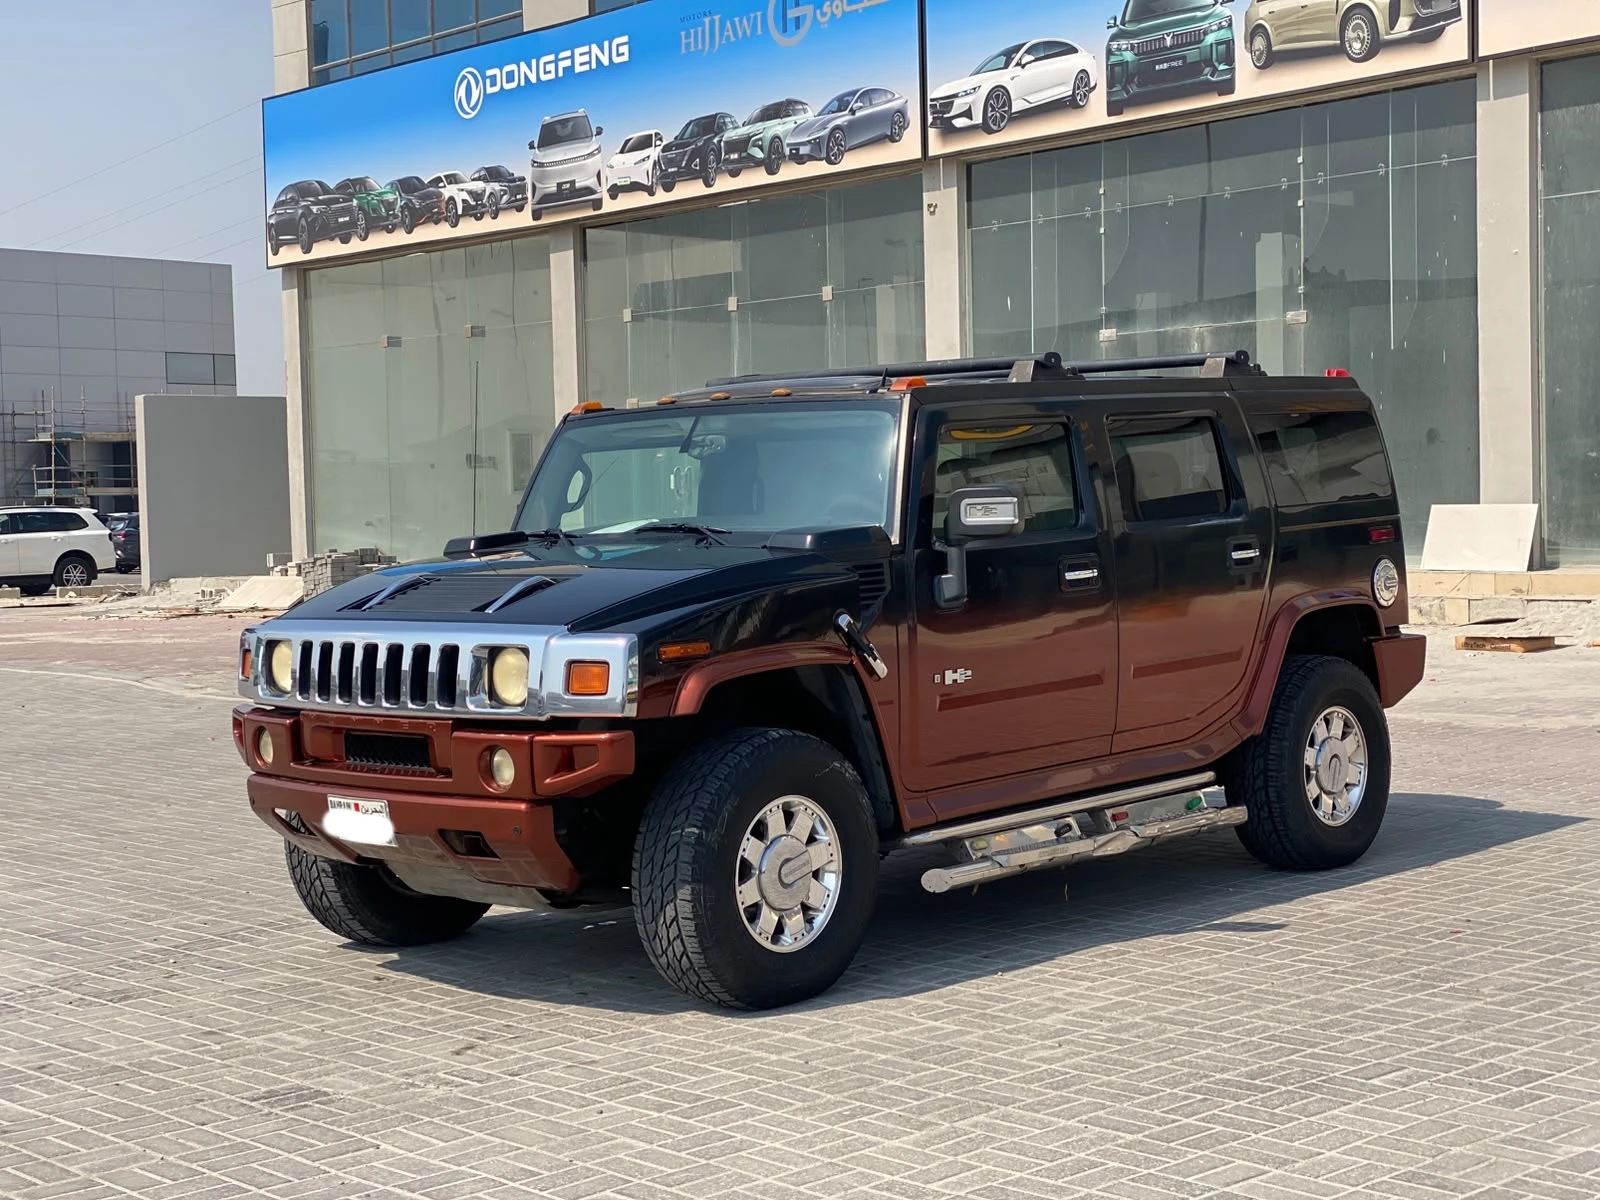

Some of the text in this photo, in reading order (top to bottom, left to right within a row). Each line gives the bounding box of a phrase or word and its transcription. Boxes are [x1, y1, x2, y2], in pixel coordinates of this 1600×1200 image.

[680, 9, 712, 23] MOTORS
[680, 11, 763, 55] HIJJAWI
[485, 35, 629, 94] DONGFENG
[944, 668, 972, 685] H2
